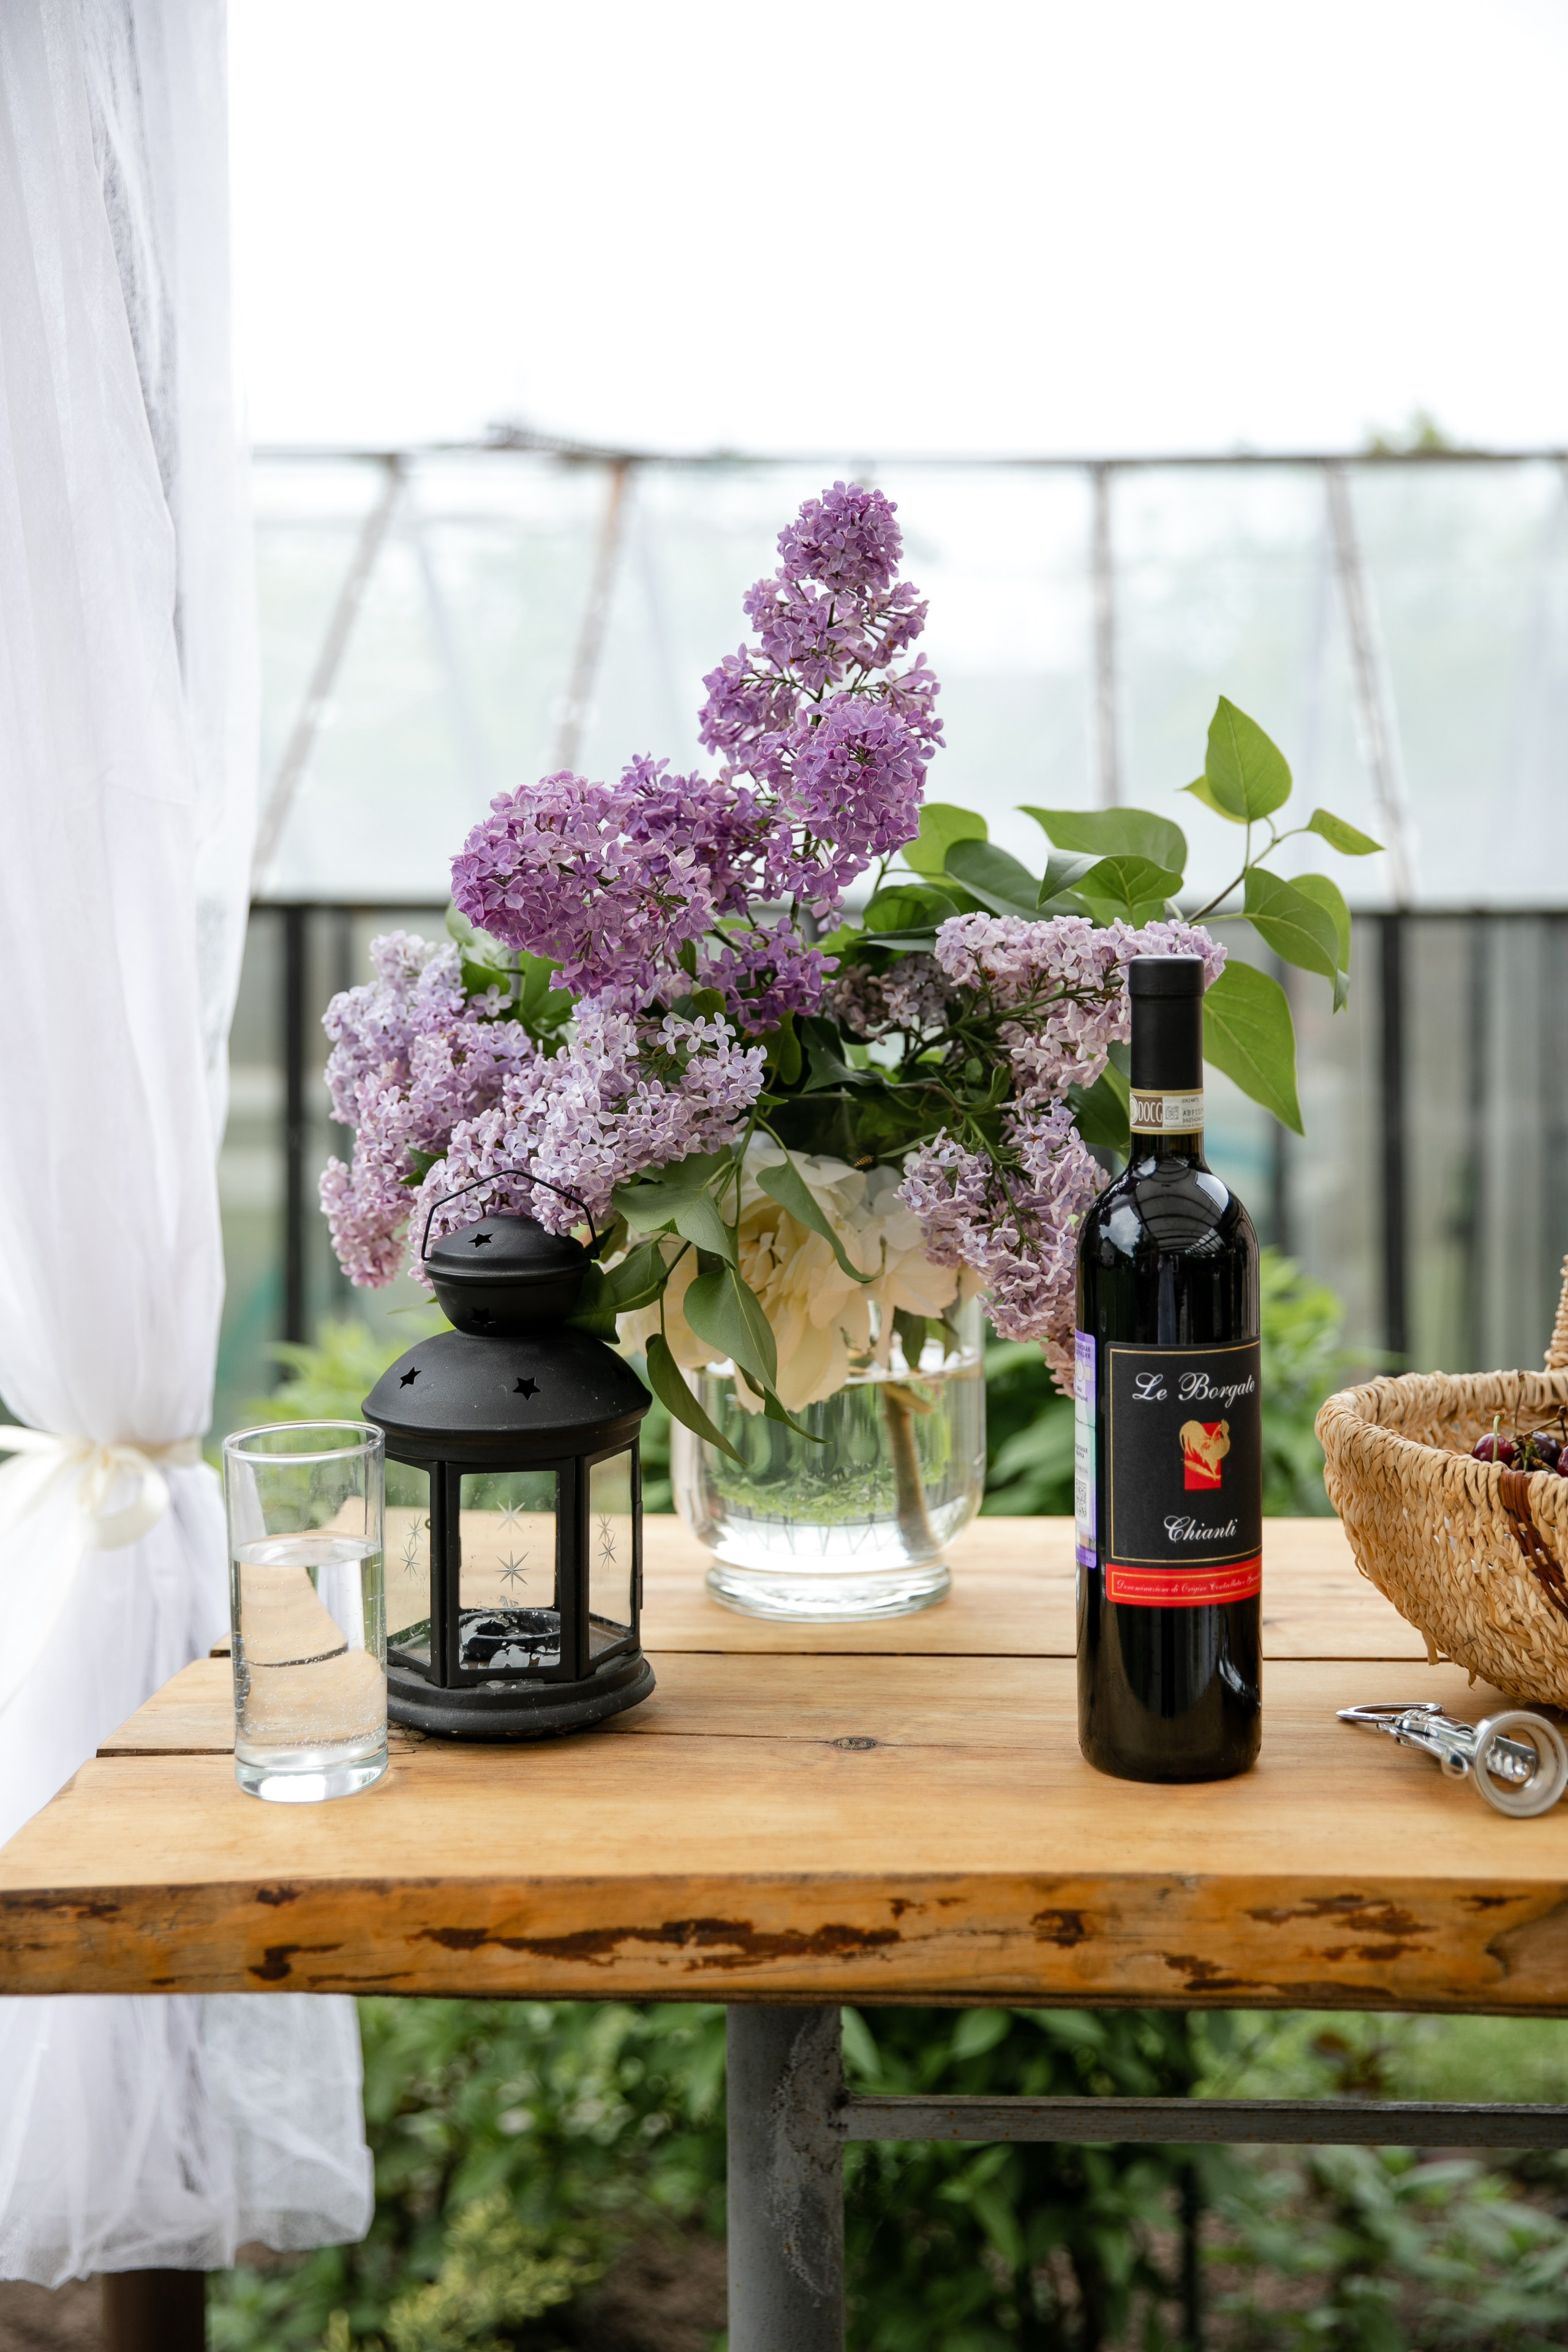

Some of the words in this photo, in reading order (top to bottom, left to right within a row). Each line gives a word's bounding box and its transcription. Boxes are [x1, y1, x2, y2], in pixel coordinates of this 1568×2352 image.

[1138, 1101, 1163, 1123] DOCG
[1131, 1372, 1168, 1401] Le
[1178, 1372, 1255, 1408] Borgate
[1163, 1515, 1238, 1544] Chianti
[1117, 1579, 1169, 1593] Denominazione
[1171, 1583, 1179, 1593] di
[1182, 1583, 1207, 1594] Origine
[1209, 1578, 1242, 1591] Controllata
